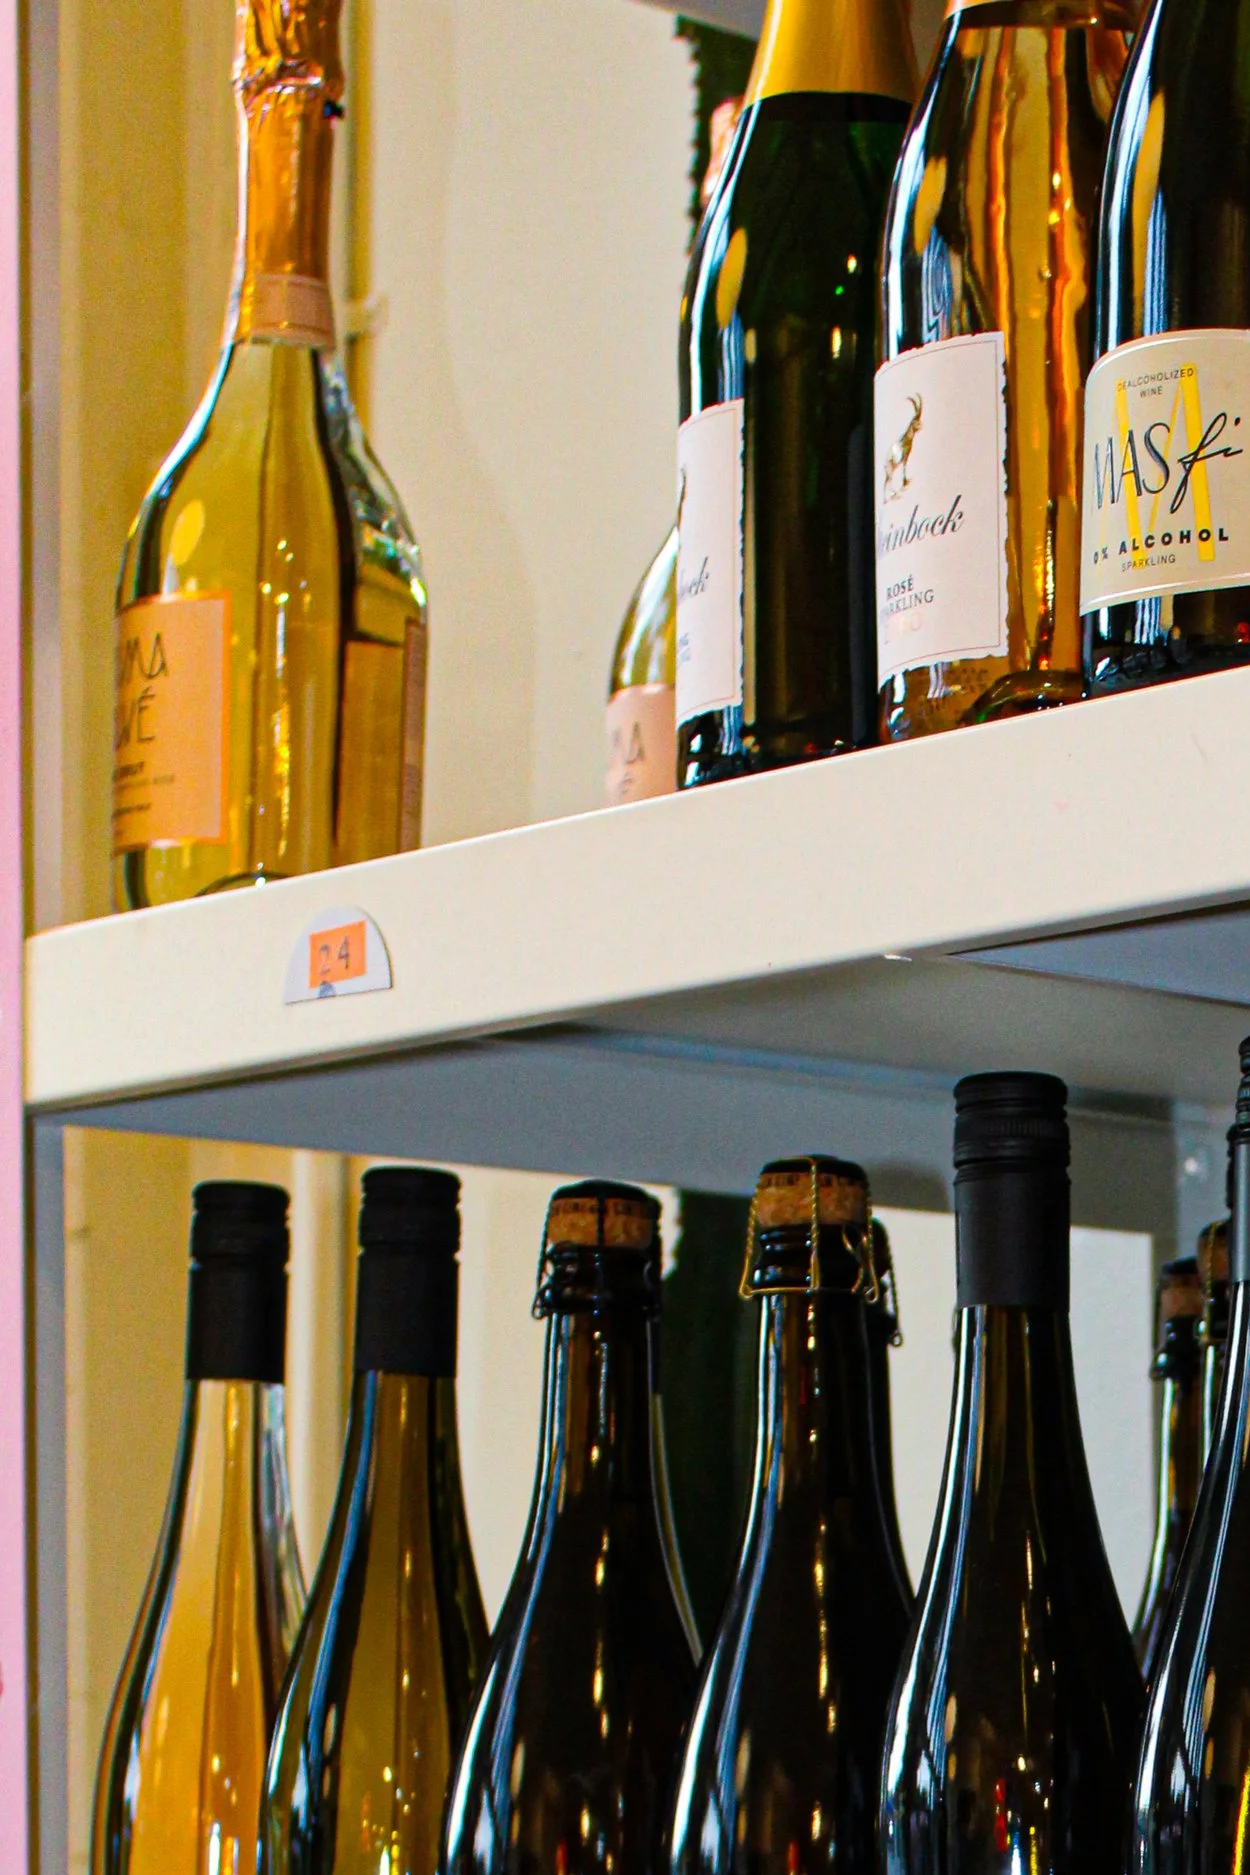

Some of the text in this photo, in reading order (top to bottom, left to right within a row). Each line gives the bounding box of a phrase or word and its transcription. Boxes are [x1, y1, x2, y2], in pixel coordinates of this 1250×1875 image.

[1117, 367, 1194, 392] DEALCOHOLIZED
[1139, 386, 1164, 398] WINE
[1118, 527, 1229, 556] ALCOHOL
[1121, 554, 1177, 573] SPARKLING
[886, 573, 914, 601] ROSÉ
